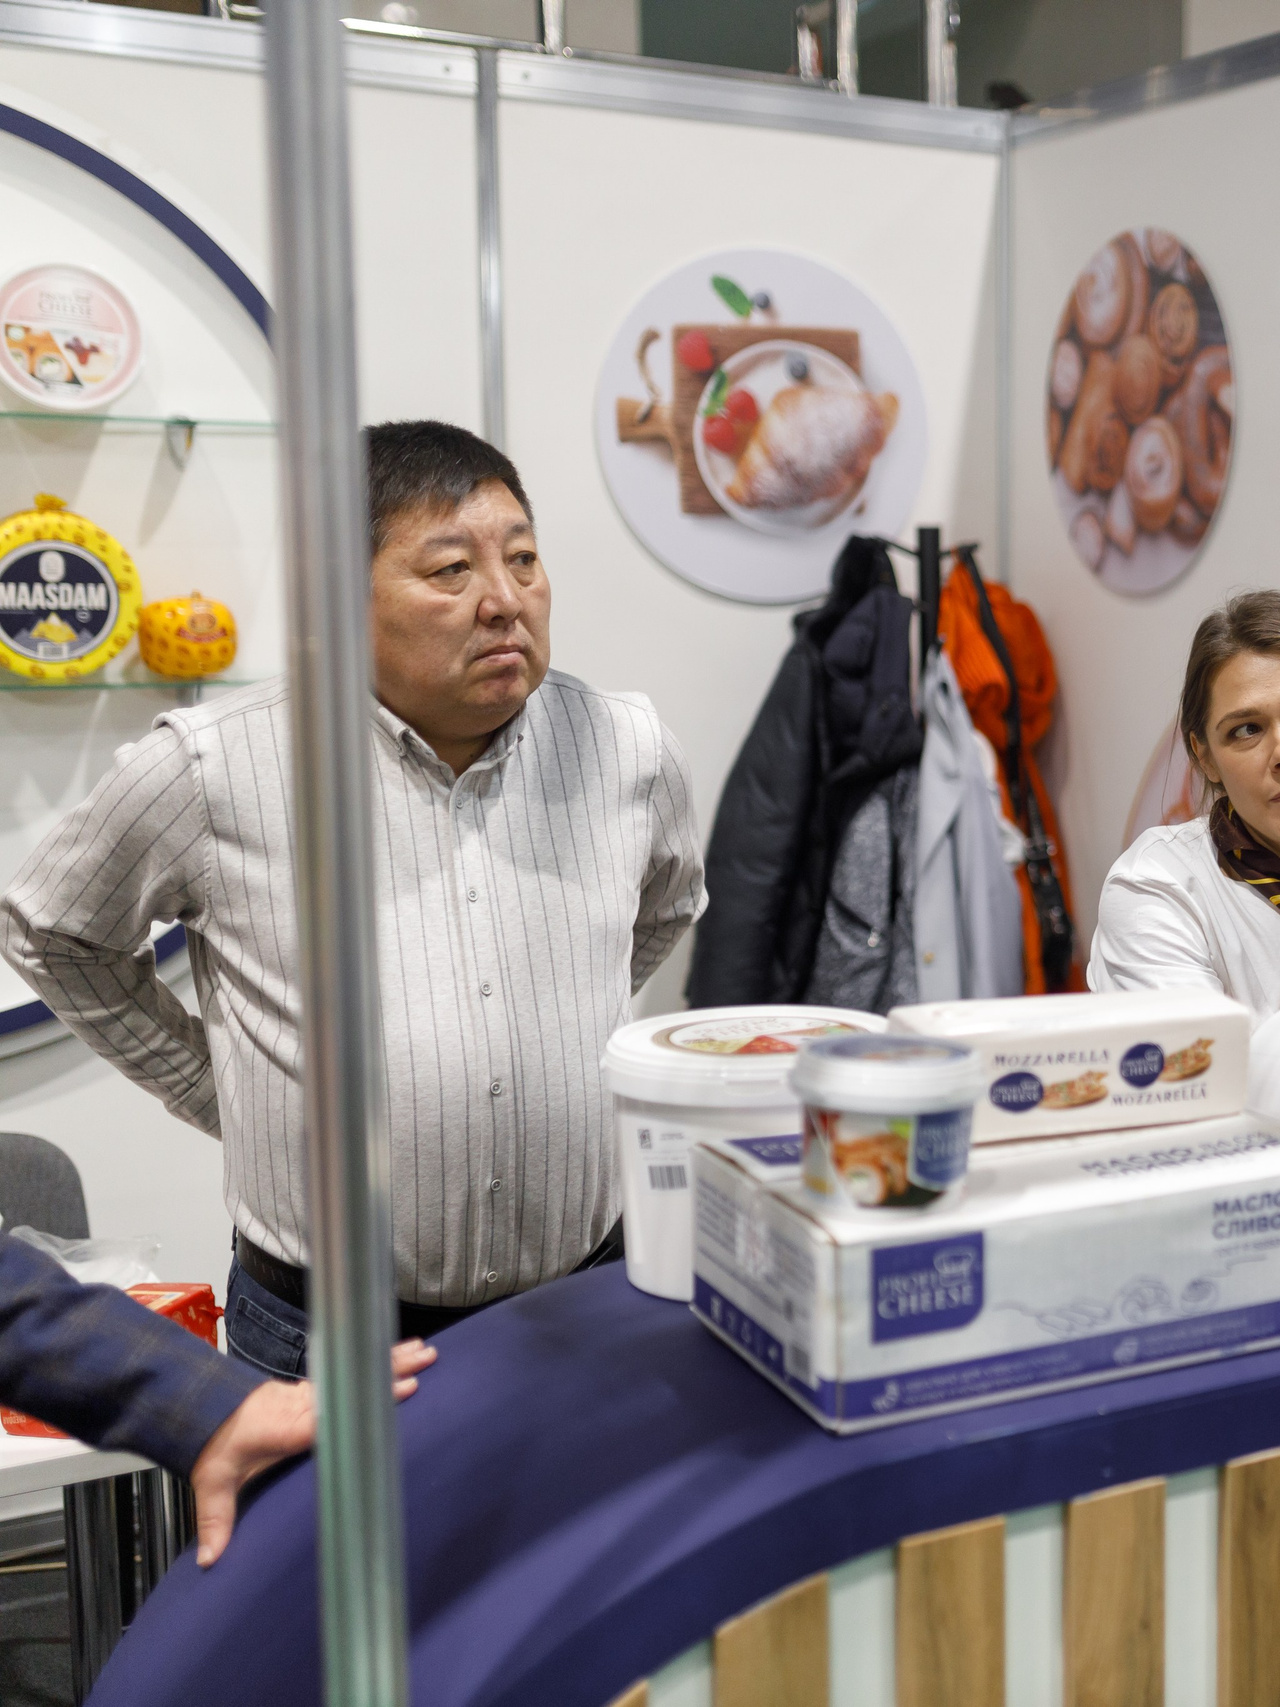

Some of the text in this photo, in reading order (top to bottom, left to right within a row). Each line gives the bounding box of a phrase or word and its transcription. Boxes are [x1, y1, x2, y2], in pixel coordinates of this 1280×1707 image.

[0, 582, 107, 611] MAASDAM
[992, 1049, 1110, 1067] MOZZARELLA
[992, 1092, 1040, 1104] CHEESE
[1110, 1085, 1208, 1107] MOZZARELLA
[877, 1284, 973, 1319] CHEESE
